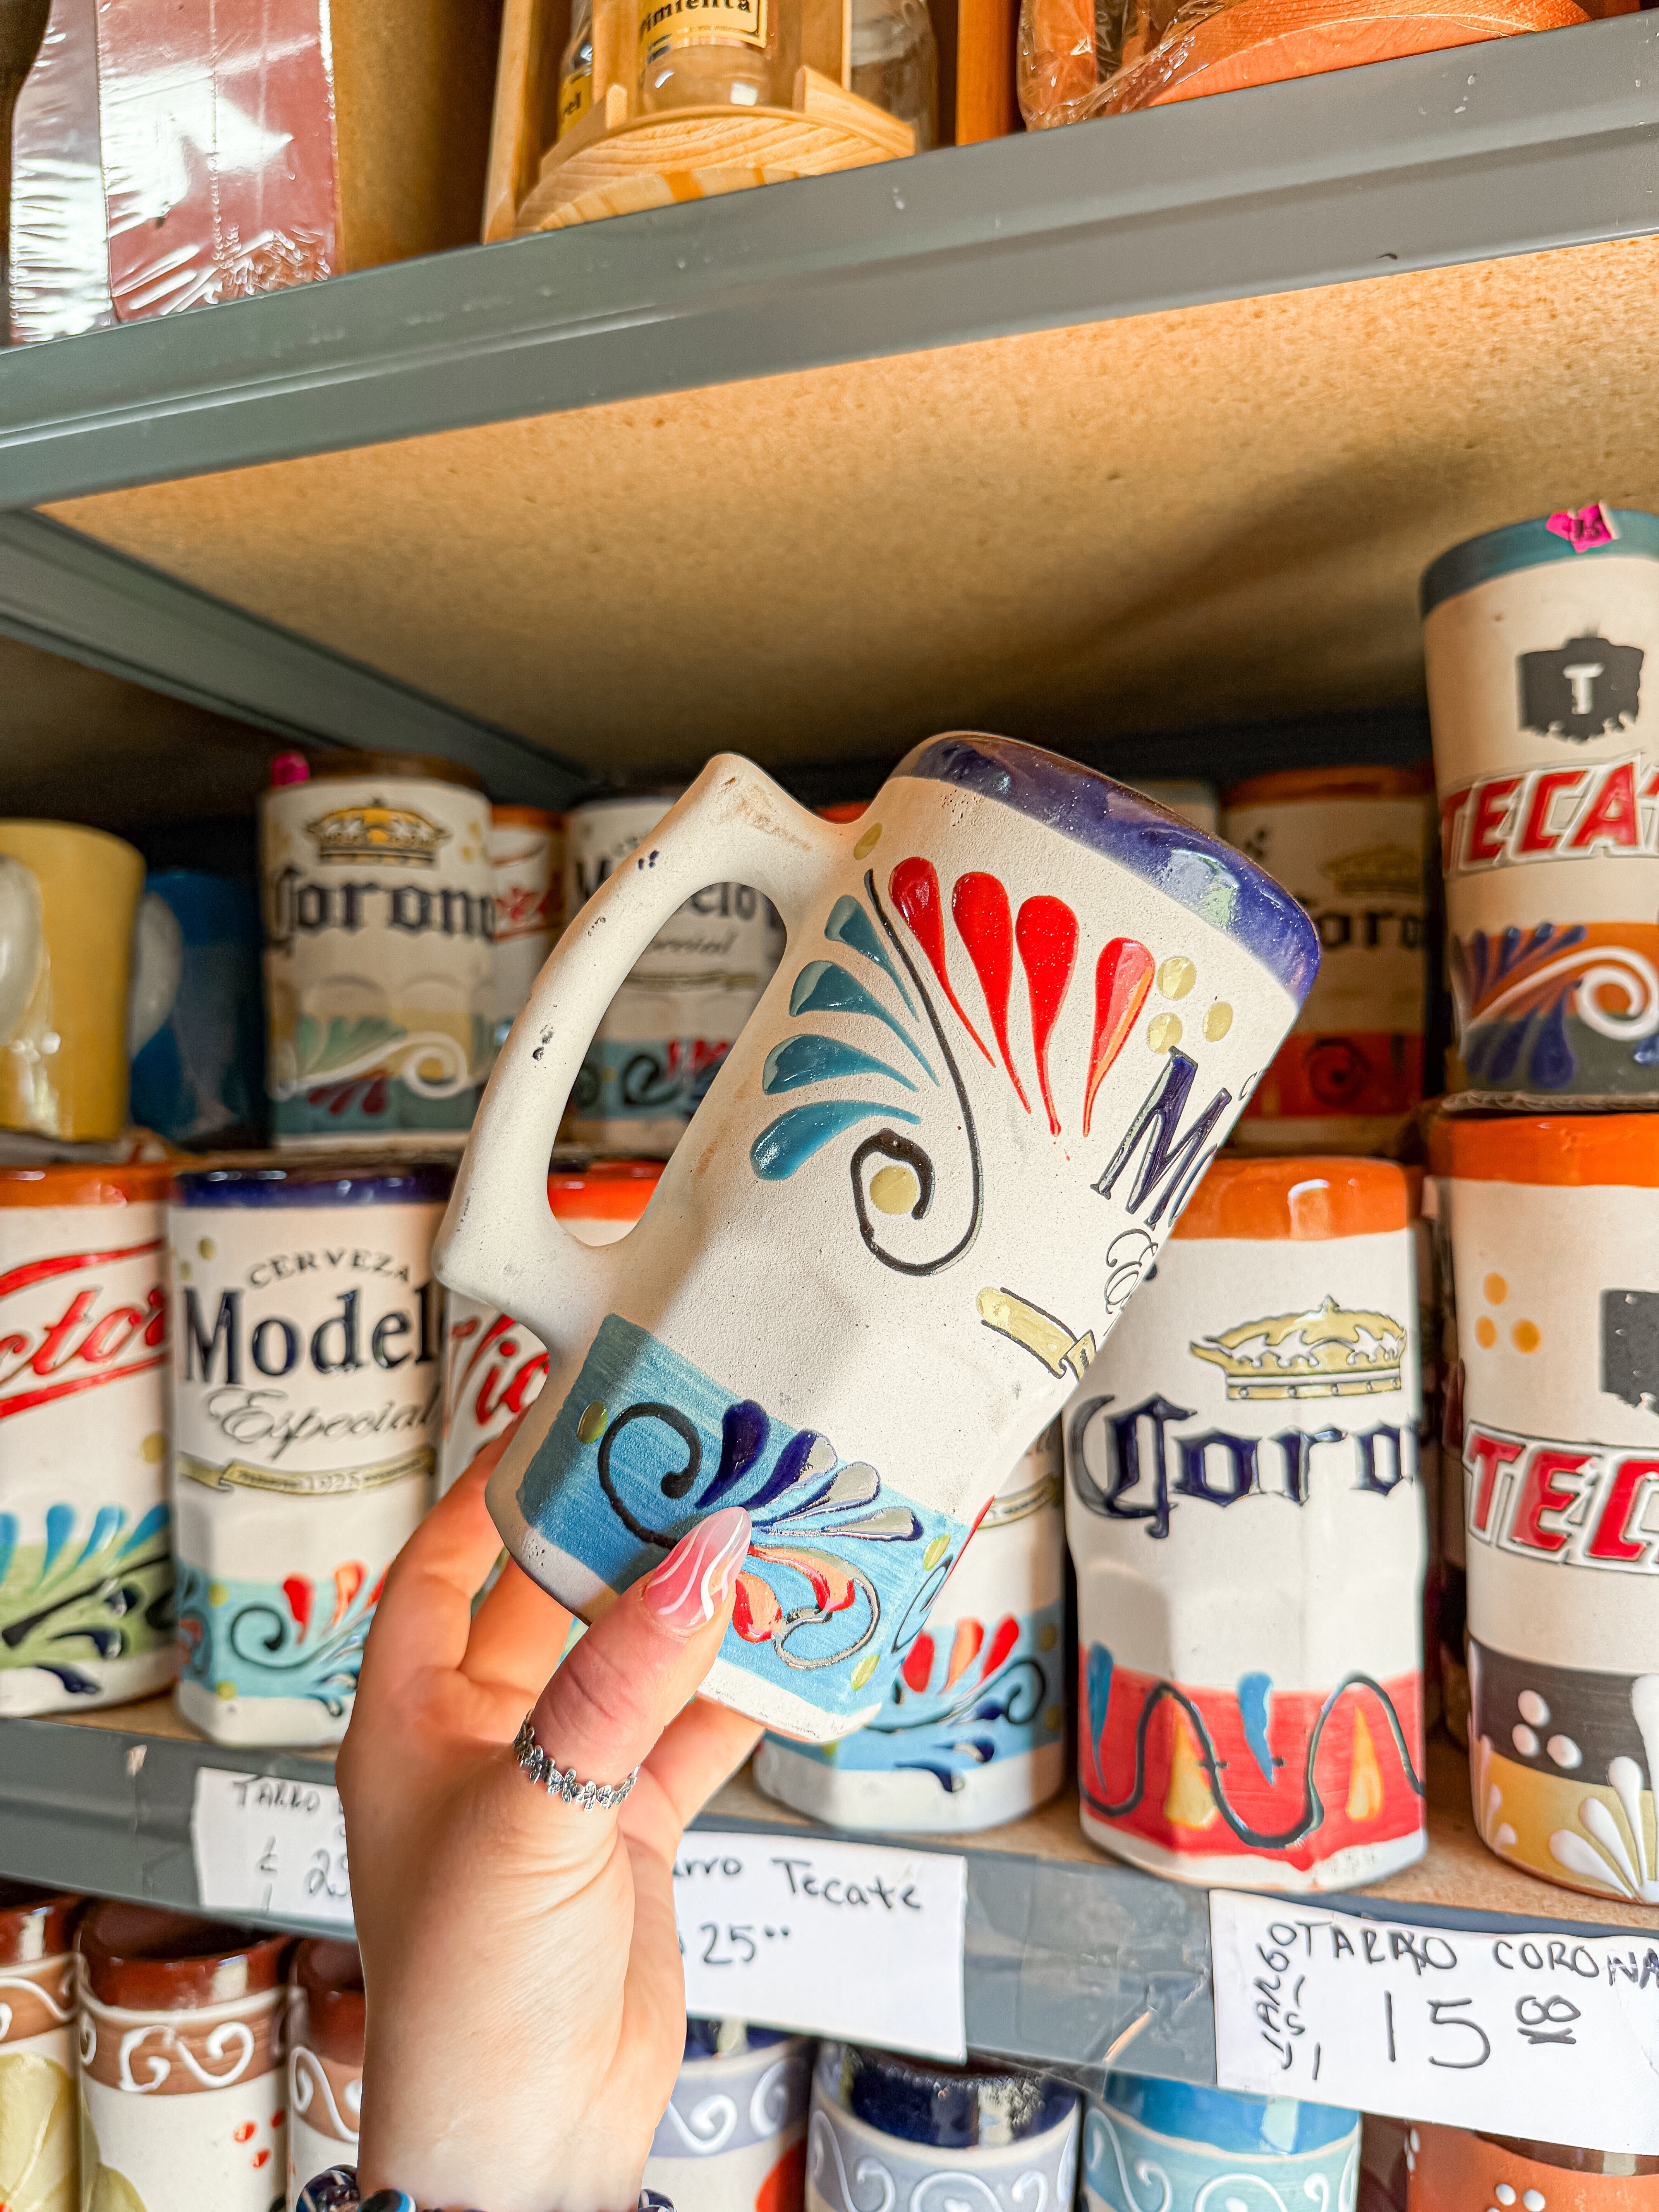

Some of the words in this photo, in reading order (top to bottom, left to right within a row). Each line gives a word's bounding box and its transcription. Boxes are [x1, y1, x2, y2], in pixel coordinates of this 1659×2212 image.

[1563, 662, 1604, 715] T
[1439, 753, 1659, 871] TECA
[249, 1248, 411, 1288] CERVEZA
[771, 1858, 921, 1910] Tecate
